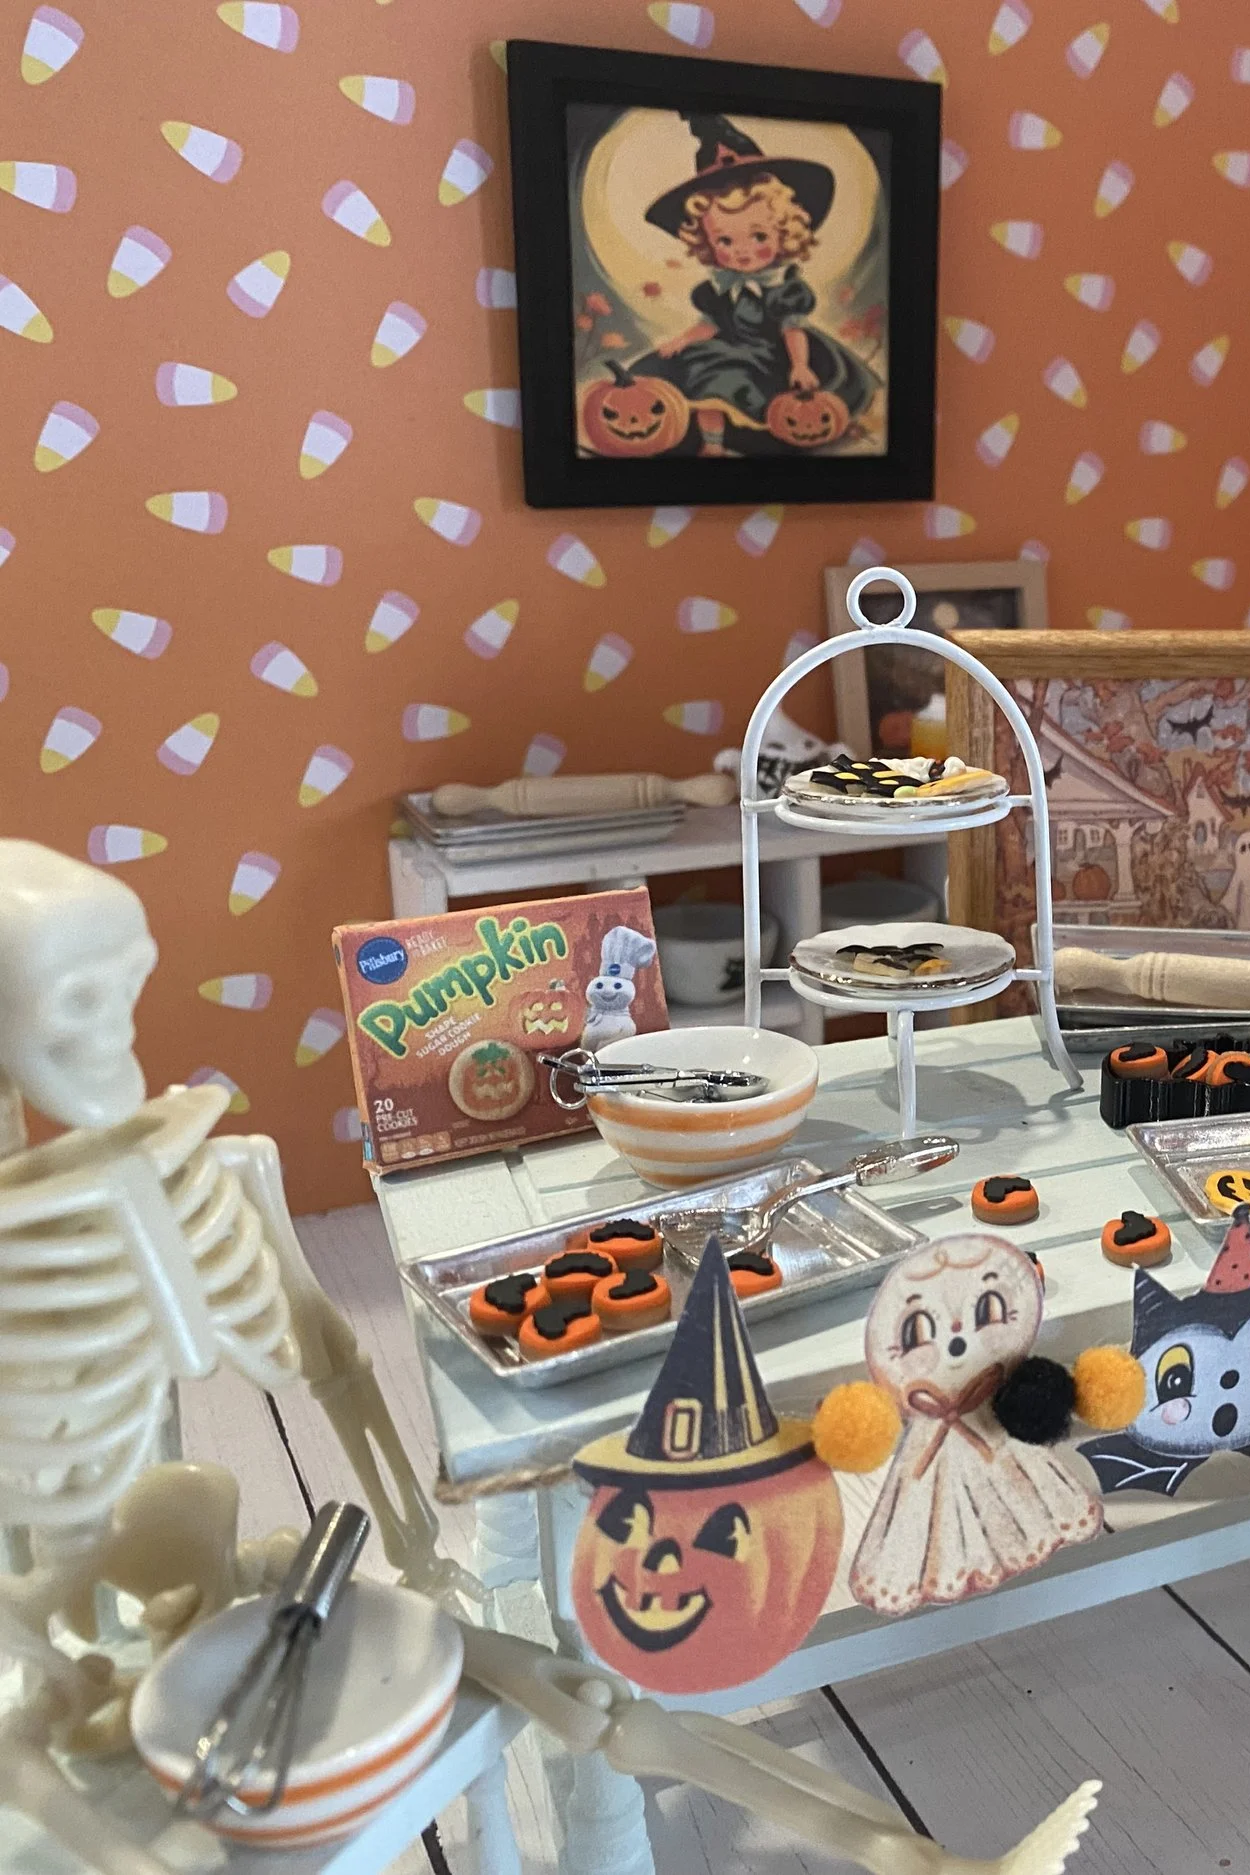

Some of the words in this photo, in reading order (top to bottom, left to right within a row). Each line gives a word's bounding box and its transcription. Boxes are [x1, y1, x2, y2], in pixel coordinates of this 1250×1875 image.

[358, 949, 405, 974] Pillsbury
[357, 917, 569, 1060] Pumpkin
[416, 1033, 449, 1058] SUGAR
[448, 1013, 481, 1040] COOKIE
[425, 1016, 457, 1039] SHAPE
[438, 1031, 472, 1057] DOUGH
[374, 1098, 394, 1114] 20
[377, 1116, 418, 1132] COOKIES
